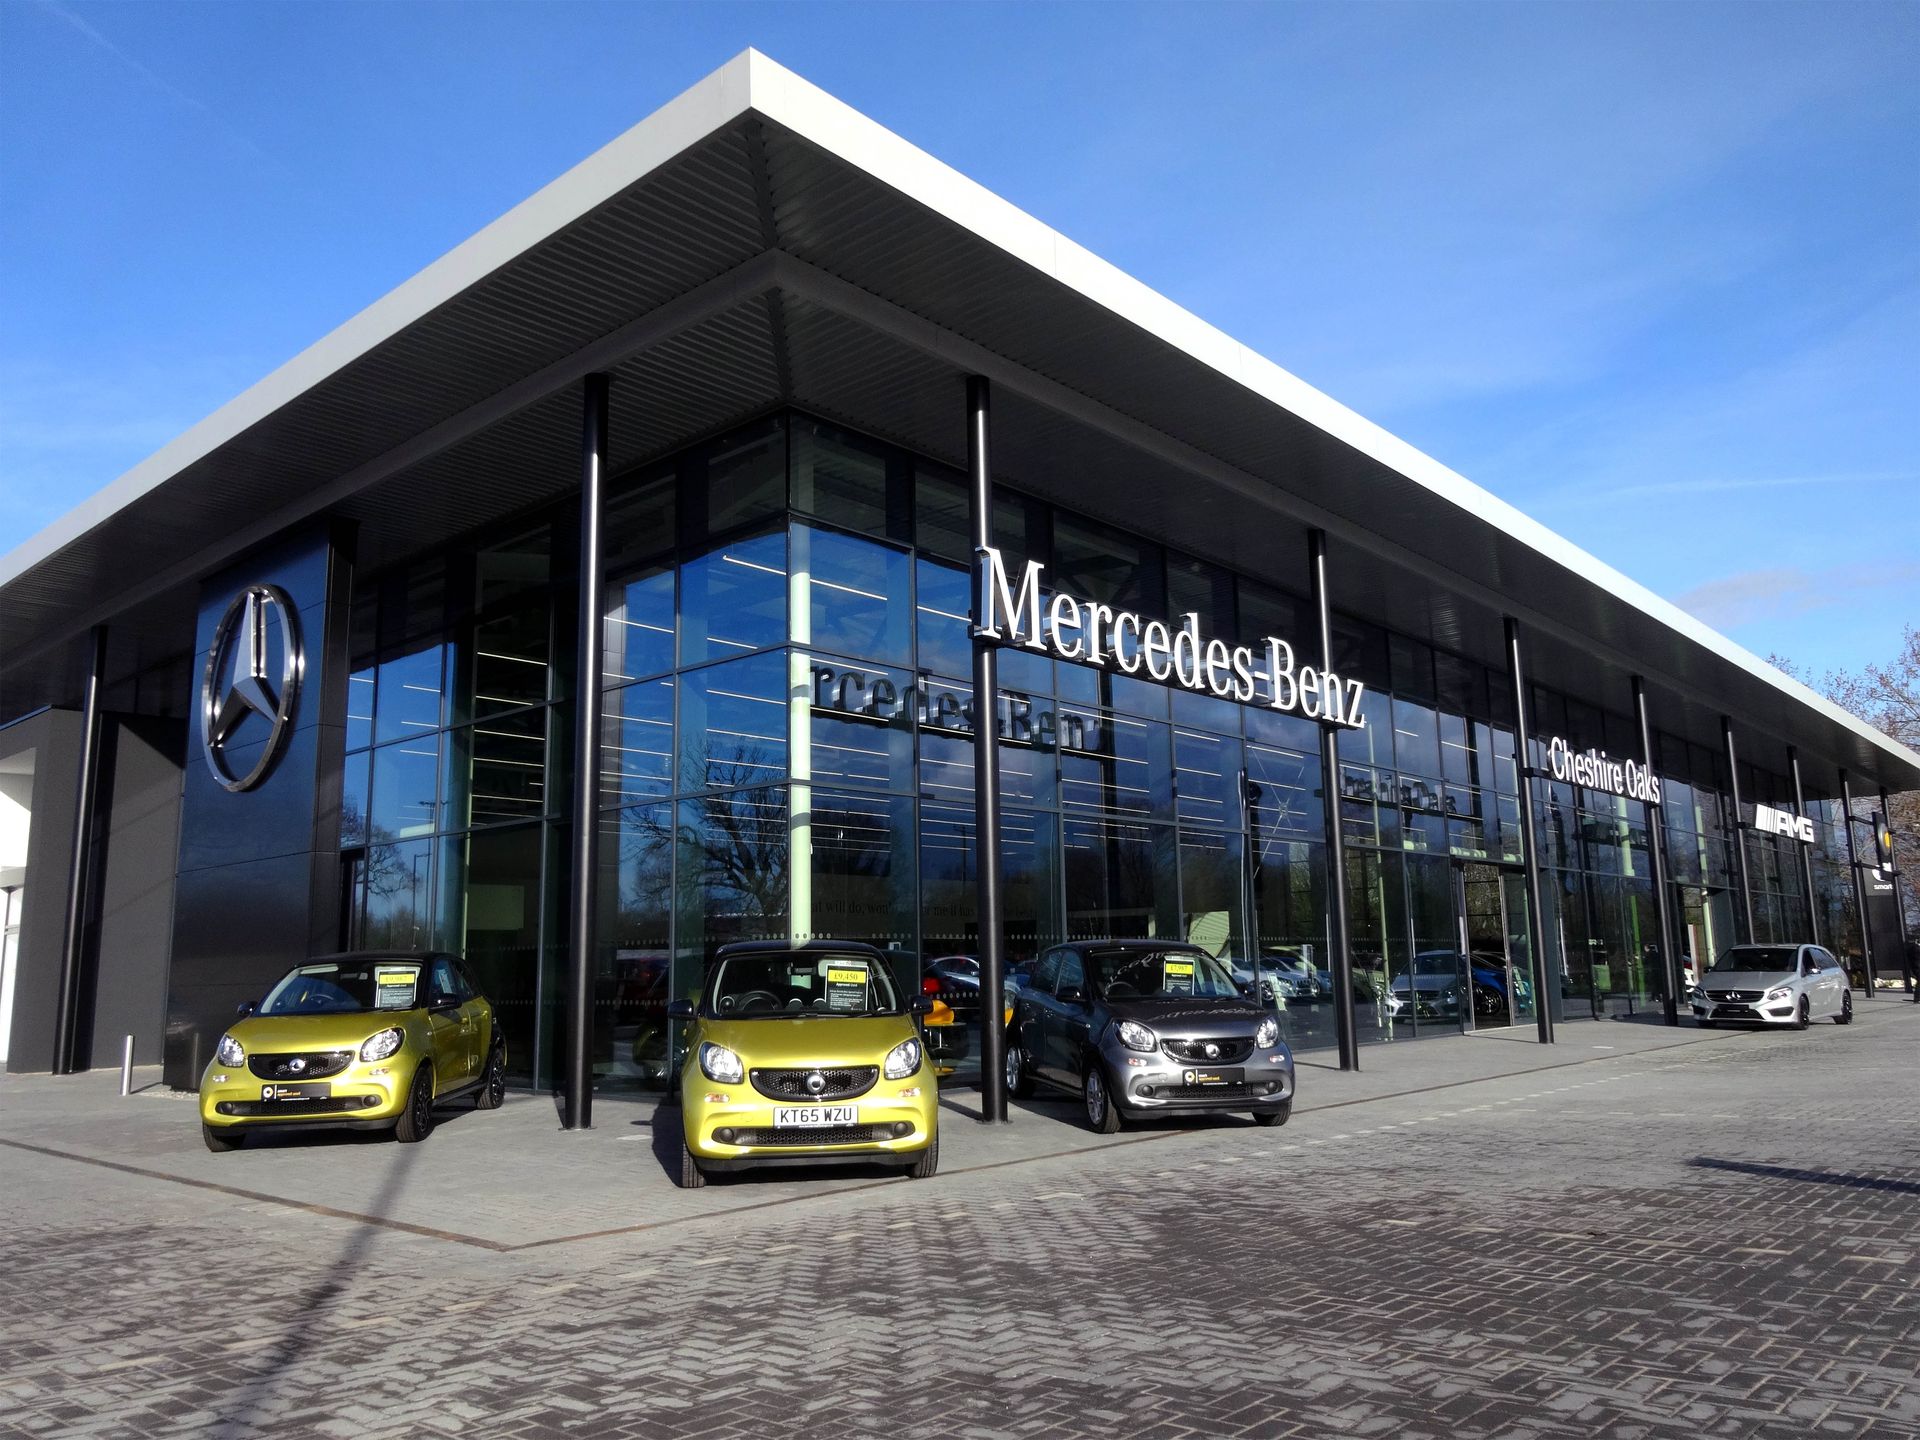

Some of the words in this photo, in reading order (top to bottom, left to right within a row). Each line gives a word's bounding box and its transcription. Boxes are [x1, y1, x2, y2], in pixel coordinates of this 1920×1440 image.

[976, 546, 1366, 729] Mercedes-Benz
[1548, 736, 1625, 793] Cheshire
[1625, 759, 1661, 804] Oaks
[1776, 807, 1815, 843] AMG
[780, 1109, 819, 1123] KT65
[824, 1107, 852, 1122] WZU
